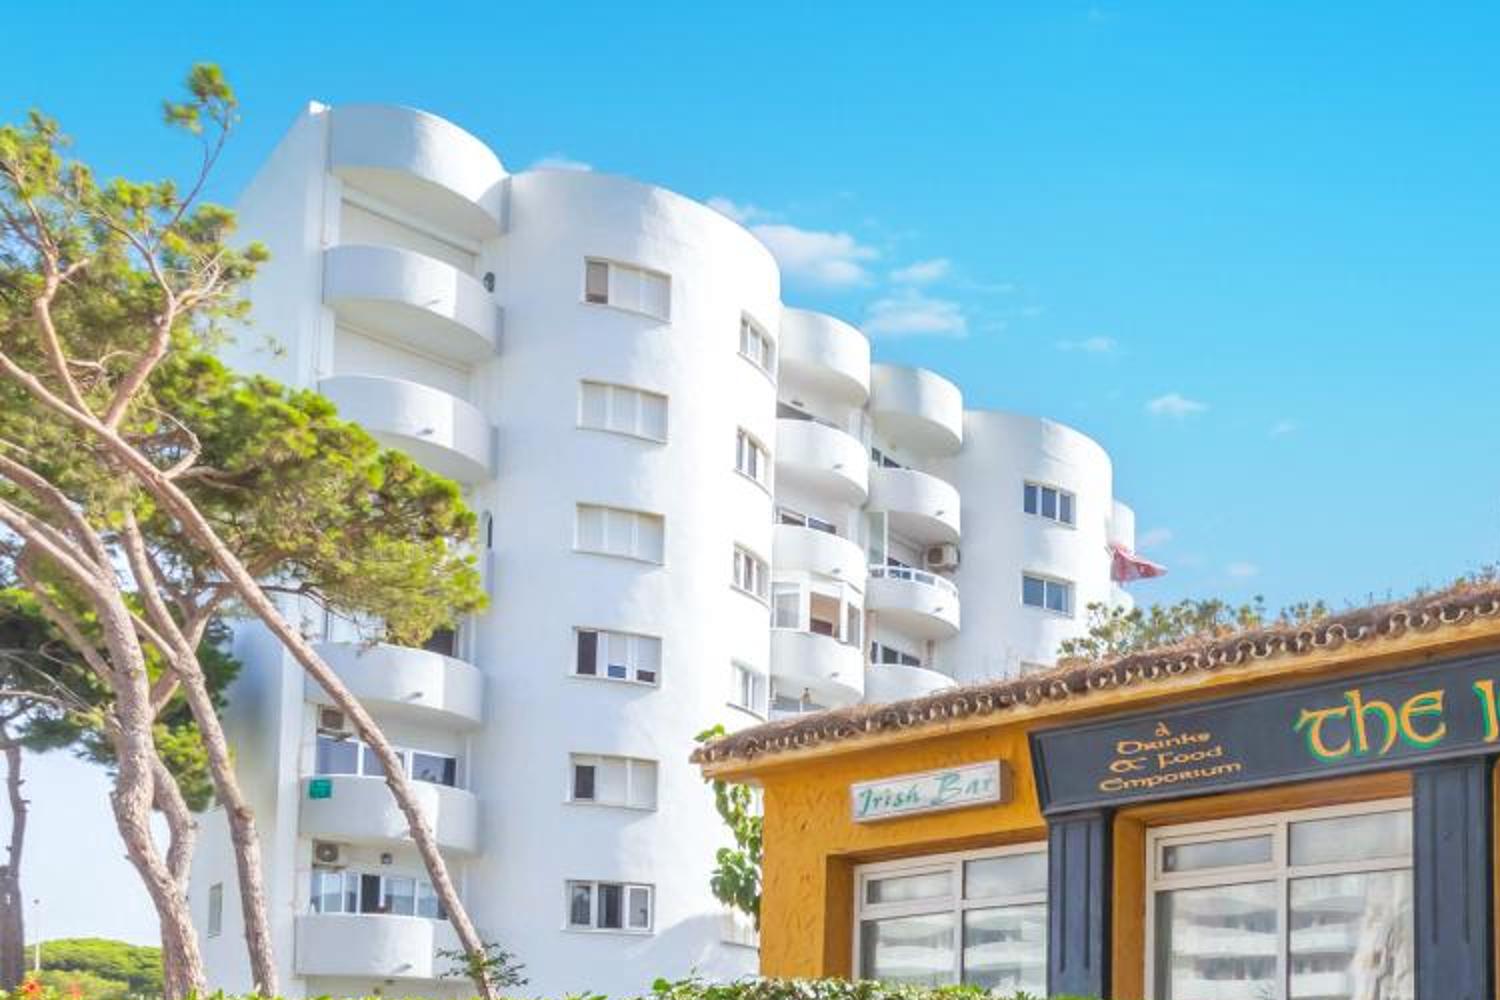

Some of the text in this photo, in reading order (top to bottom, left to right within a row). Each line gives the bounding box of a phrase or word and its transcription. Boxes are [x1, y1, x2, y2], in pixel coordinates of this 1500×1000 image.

[1116, 731, 1211, 755] Drinks
[1157, 745, 1223, 769] Food
[1099, 762, 1242, 791] Emporium
[857, 771, 993, 817] Irish Bar
